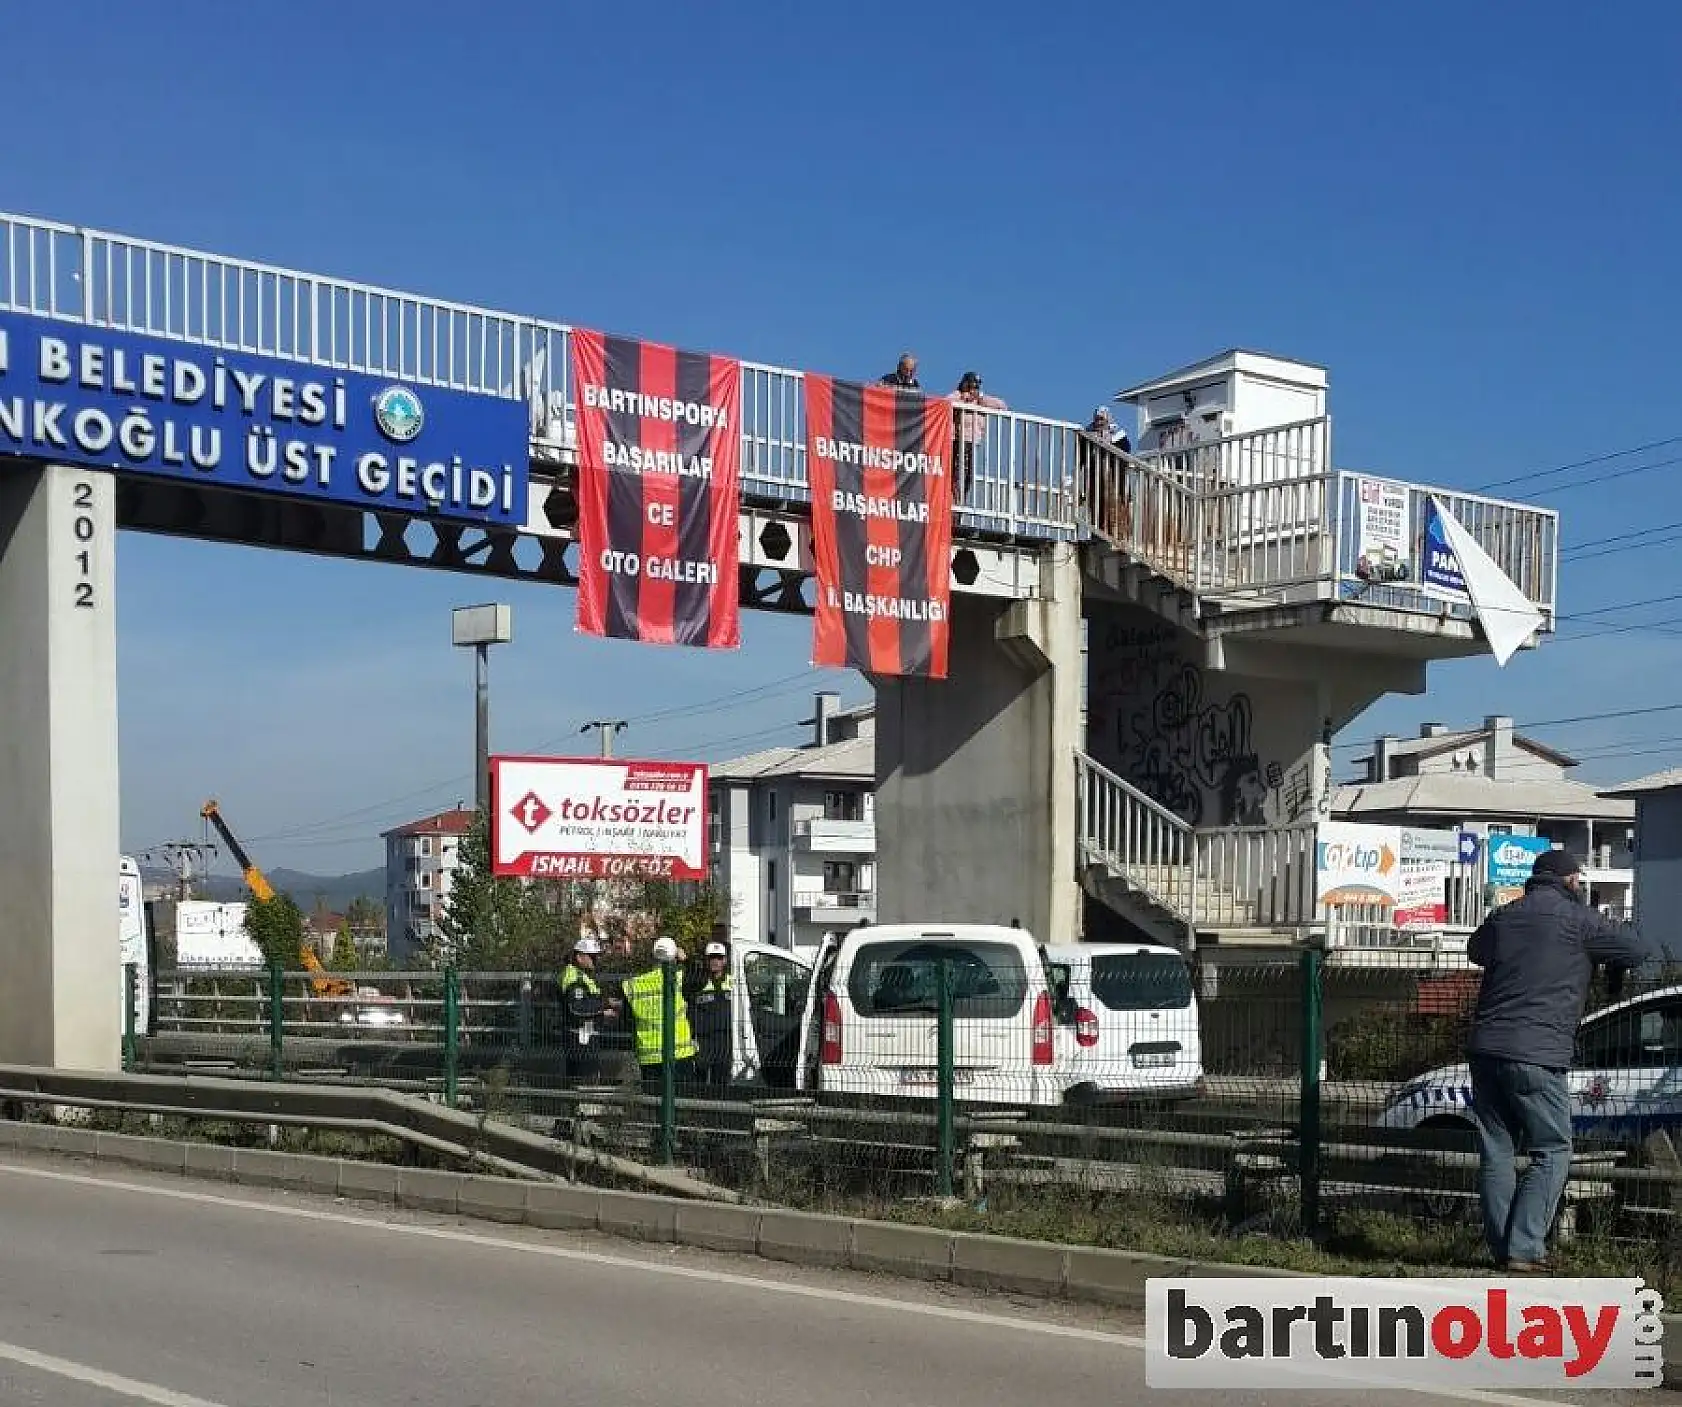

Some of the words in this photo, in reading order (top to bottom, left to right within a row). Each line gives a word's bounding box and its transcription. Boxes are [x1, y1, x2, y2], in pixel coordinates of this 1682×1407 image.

[41, 336, 346, 426] BELEDİYESİ
[248, 425, 337, 484] ÜST
[358, 452, 513, 508] GEÇİDİ
[647, 502, 674, 526] CE
[75, 483, 94, 609] 2012
[866, 544, 902, 568] CHP
[601, 549, 640, 576] OTO
[561, 795, 695, 825] toksözler
